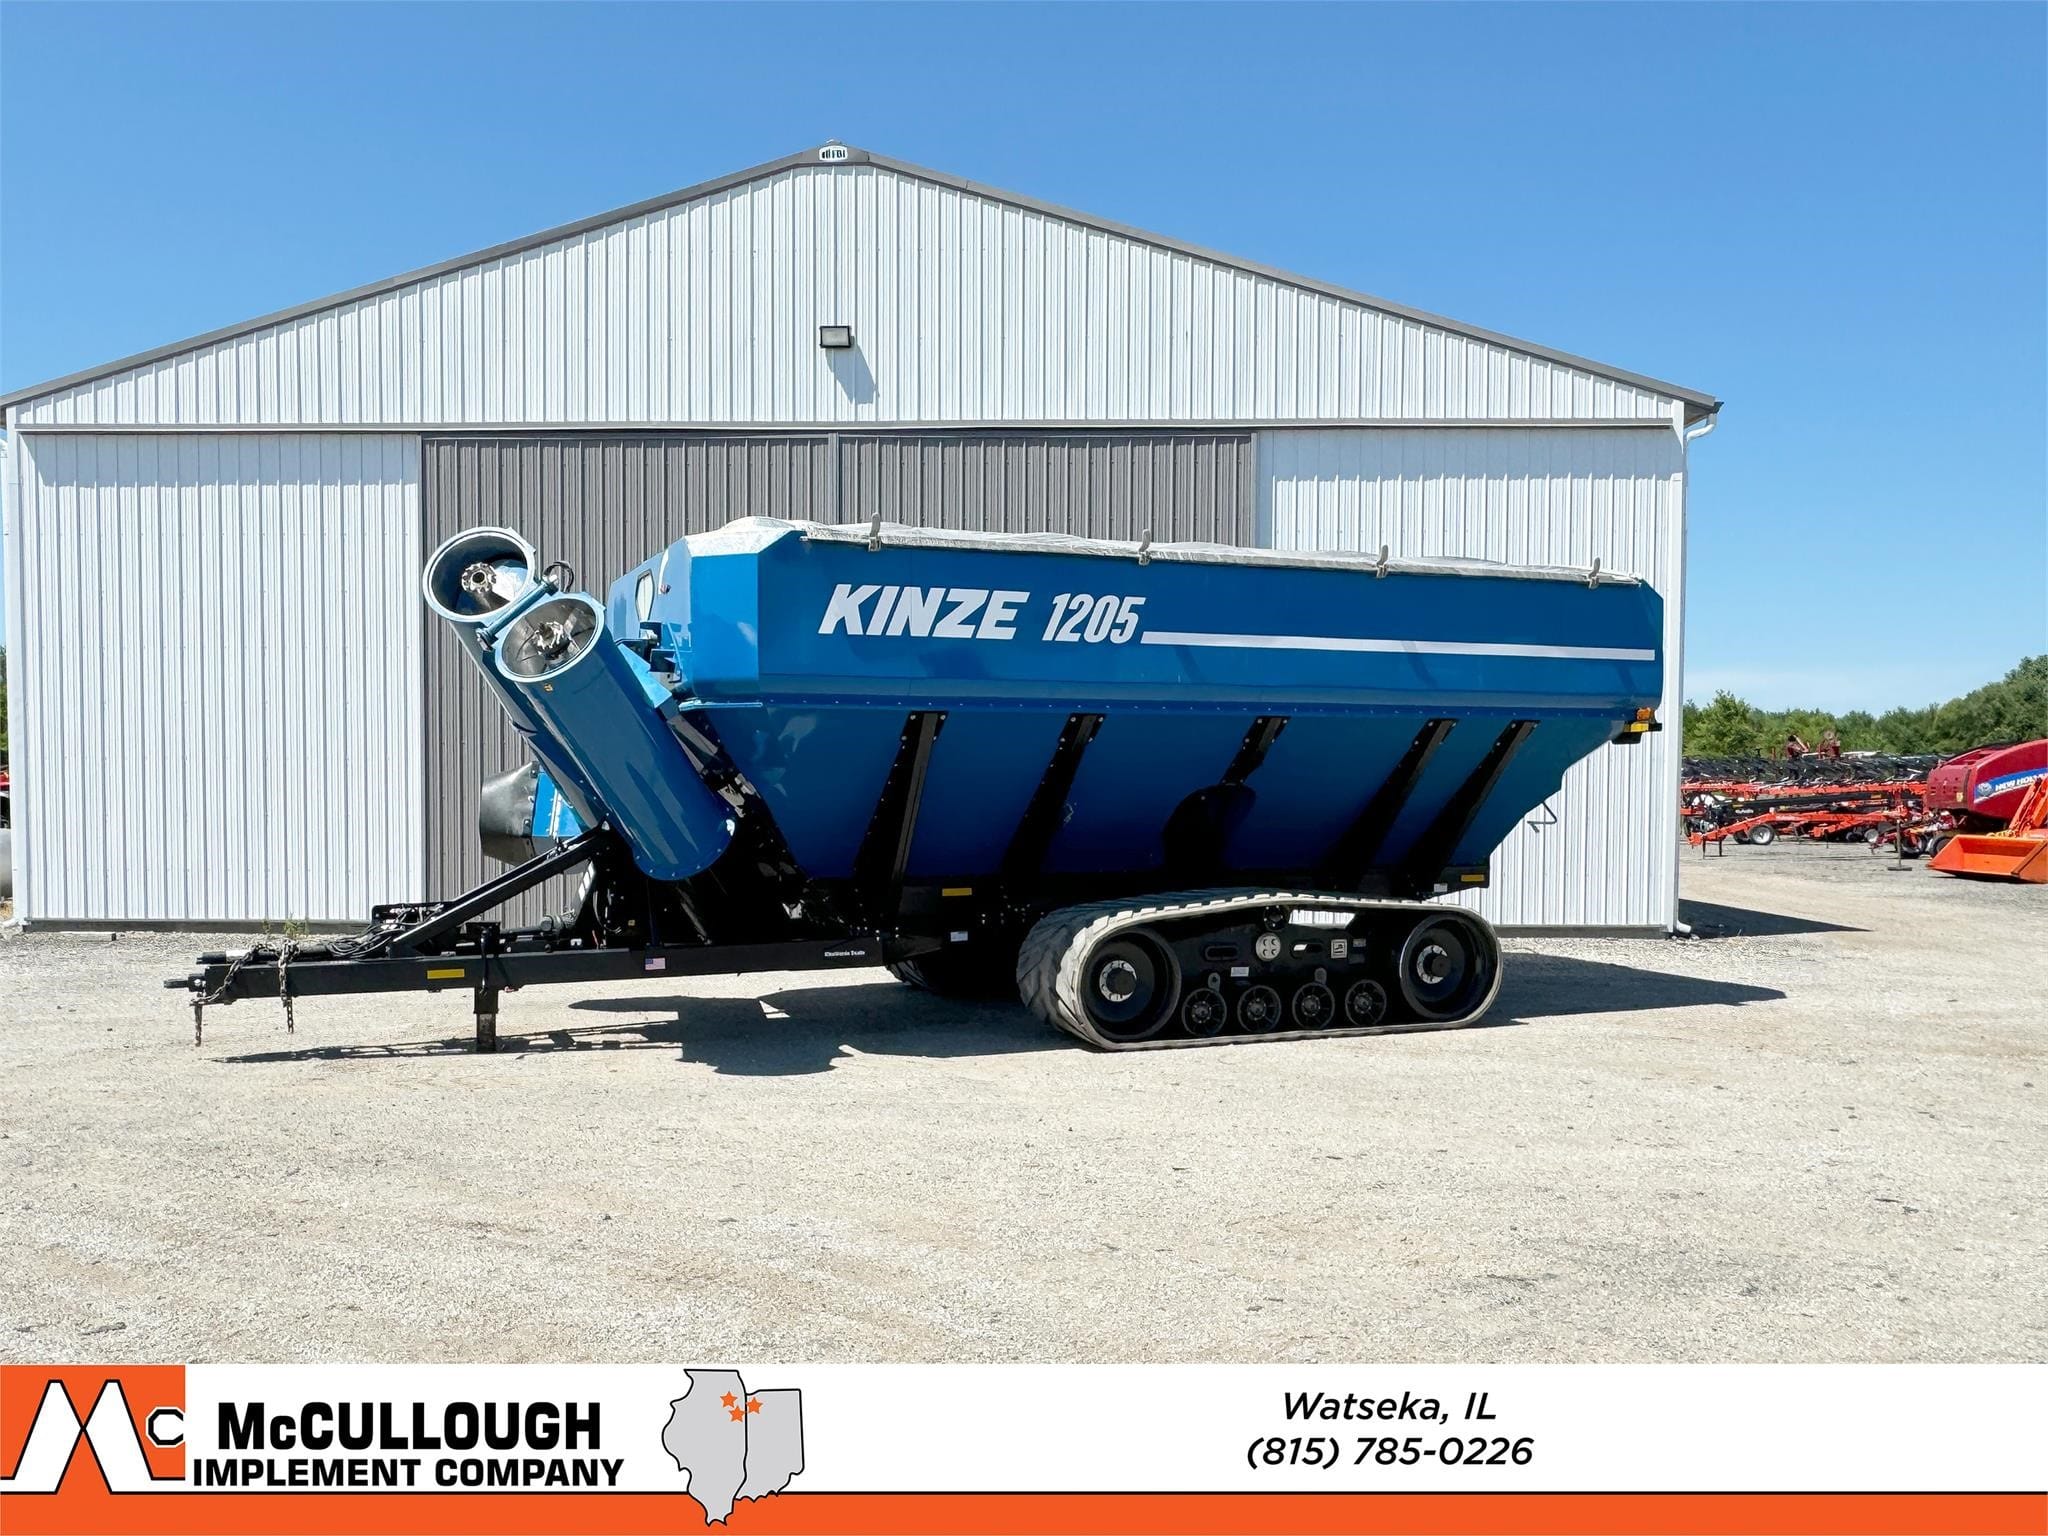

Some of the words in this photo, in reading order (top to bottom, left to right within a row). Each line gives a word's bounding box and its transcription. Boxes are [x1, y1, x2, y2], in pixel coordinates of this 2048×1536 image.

[818, 583, 1031, 640] KINZE
[1042, 593, 1147, 644] 1205
[1995, 780, 2015, 791] NEW
